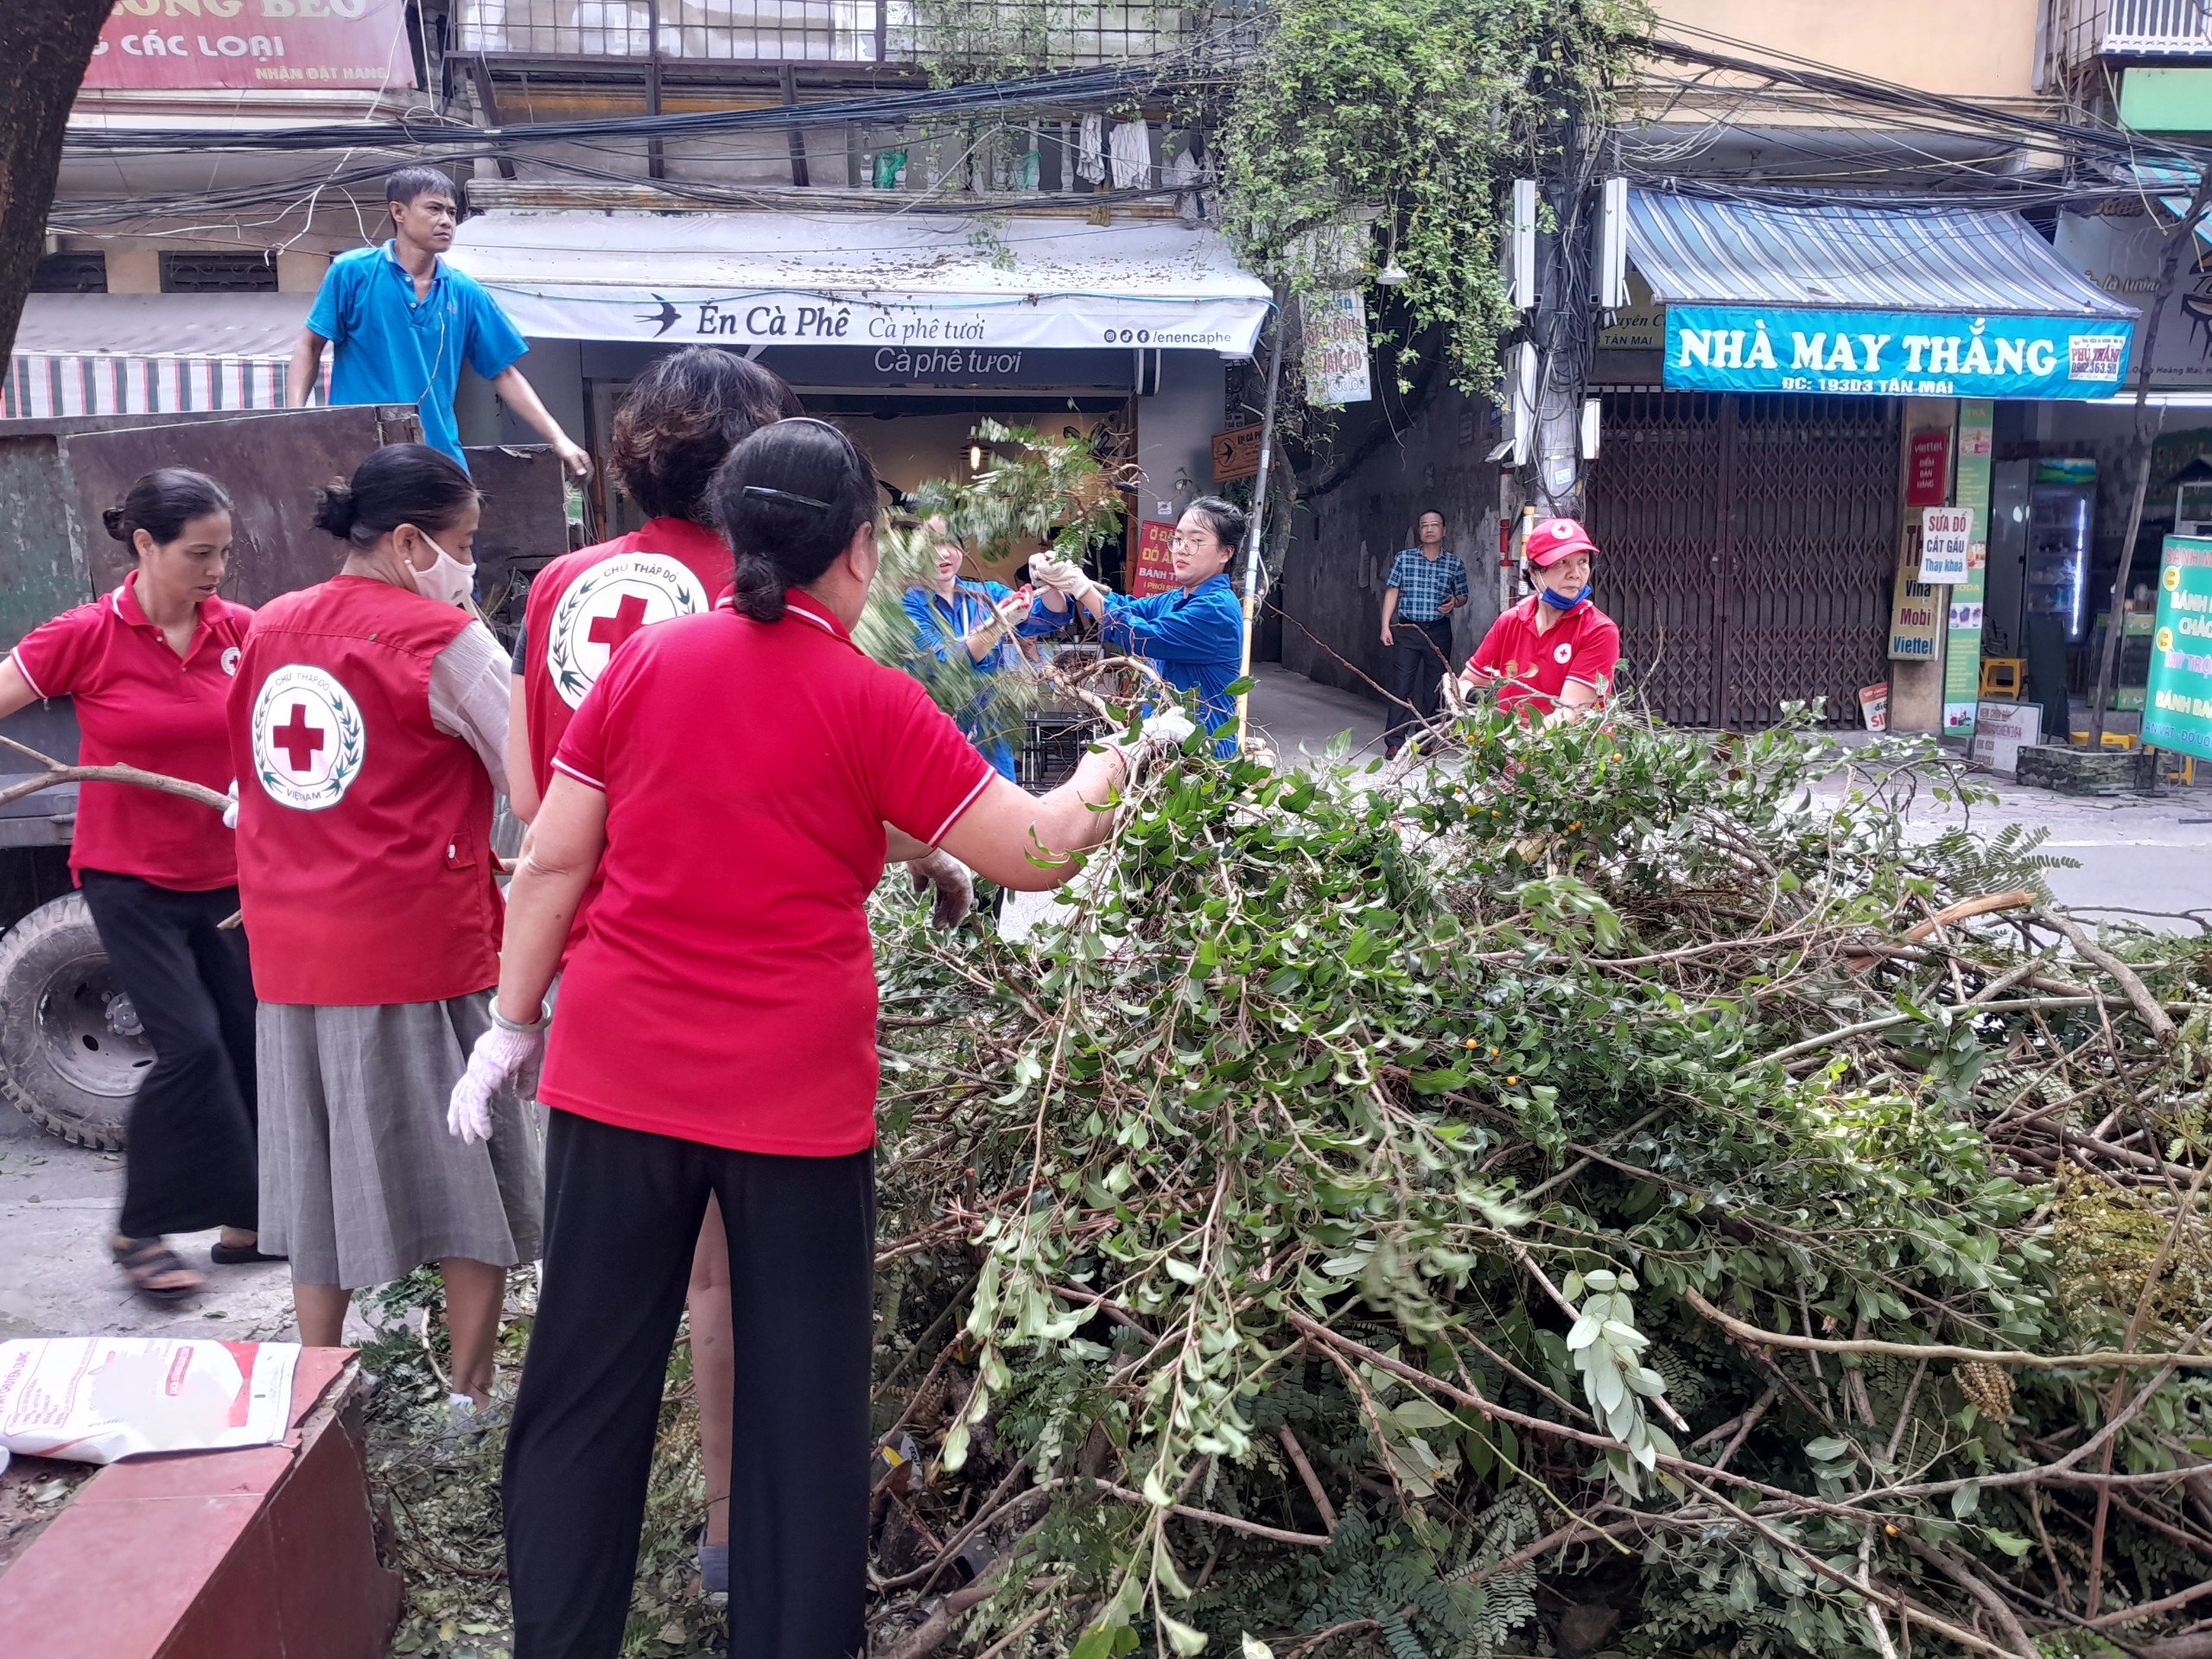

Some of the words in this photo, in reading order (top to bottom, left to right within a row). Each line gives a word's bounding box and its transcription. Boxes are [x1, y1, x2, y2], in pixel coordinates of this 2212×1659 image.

[121, 29, 189, 56] CÁC
[197, 35, 285, 62] LOẠI
[255, 66, 303, 82] NHẬN
[305, 65, 338, 82] ĐẶT
[747, 305, 787, 336] Cà
[795, 307, 851, 337] Phê
[868, 316, 896, 340] Cà
[902, 318, 941, 345] phê
[944, 314, 985, 340] tươi
[1617, 314, 1649, 330] uyên
[1153, 331, 1232, 346] /enencaphe
[1604, 334, 1628, 346] TÂN
[1630, 336, 1653, 346] MAI
[1678, 319, 1777, 371] NHÀ
[1789, 331, 1891, 372] MAY
[1902, 317, 2057, 377] THẮNG
[874, 346, 907, 373] Cà
[913, 346, 963, 378] phê
[966, 349, 1022, 374] tươi
[1782, 377, 1812, 391] ĐC:
[1878, 377, 1920, 394] TÂN
[1923, 380, 1954, 394] MAI
[1914, 440, 1943, 454] viettel
[1928, 508, 1949, 532] SỬA
[1952, 511, 1967, 533] ĐỒ
[1926, 535, 1945, 553] CẮT
[1946, 535, 1966, 554] GẤU
[2164, 544, 2199, 566] BÁNH
[1139, 567, 1166, 581] BÁNH
[1925, 557, 1942, 574] Thay
[1905, 580, 1931, 597] Vina
[1953, 583, 1980, 593] SODA
[2171, 589, 2208, 613] BÁNH
[1899, 607, 1932, 626] Mobi
[1893, 635, 1934, 655] Viettel
[2155, 690, 2191, 715] BÁNH
